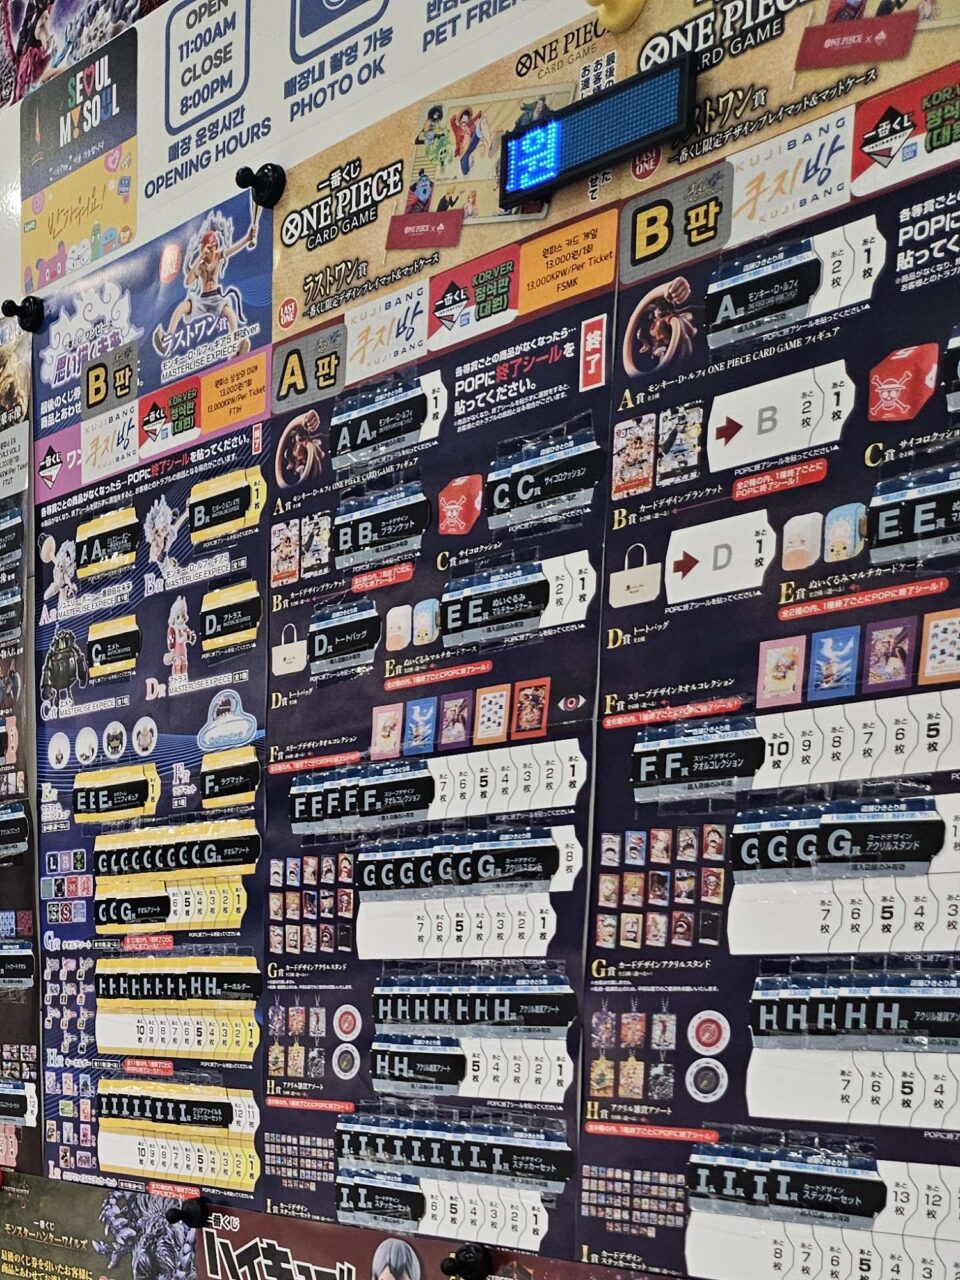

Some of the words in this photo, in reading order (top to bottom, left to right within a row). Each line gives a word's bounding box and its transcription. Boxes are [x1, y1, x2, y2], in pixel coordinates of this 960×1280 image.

[178, 12, 237, 62] 11:00AM
[423, 14, 460, 52] PET
[730, 18, 782, 55] GAME
[181, 43, 233, 86] CLOSE
[284, 61, 324, 99] 매장내
[363, 27, 393, 56] 가능
[180, 70, 233, 116] 8:00PM
[290, 73, 353, 122] PHOTO
[357, 55, 386, 84] OK
[169, 136, 191, 162] 매장
[195, 105, 245, 149] 운영시간
[145, 146, 211, 199] OPENING
[215, 117, 271, 161] HOURS
[319, 160, 361, 189] 一番くじ
[334, 164, 402, 218] PIECE
[307, 225, 338, 250] CARD
[341, 207, 377, 232] GAME
[635, 205, 670, 260] B
[687, 200, 721, 244] 판
[588, 251, 614, 268] Ticket
[831, 260, 842, 273] 2
[862, 267, 873, 280] 枚
[864, 249, 873, 265] 1
[280, 300, 295, 316] LAST
[281, 311, 295, 323] ONE
[585, 330, 602, 375] 終了
[708, 360, 726, 375] ONE
[727, 354, 752, 370] PIECE
[753, 347, 775, 363] CARD
[776, 338, 802, 356] GAME
[89, 365, 106, 406] B
[114, 366, 132, 397] 판
[278, 351, 306, 398] A
[316, 352, 337, 389] 판
[756, 404, 778, 436] B
[711, 543, 732, 571] D
[801, 739, 811, 752] 9
[831, 735, 842, 748] 8
[863, 732, 874, 745] 7
[894, 728, 906, 741] 6
[925, 721, 941, 739] 5
[768, 741, 789, 757] 10
